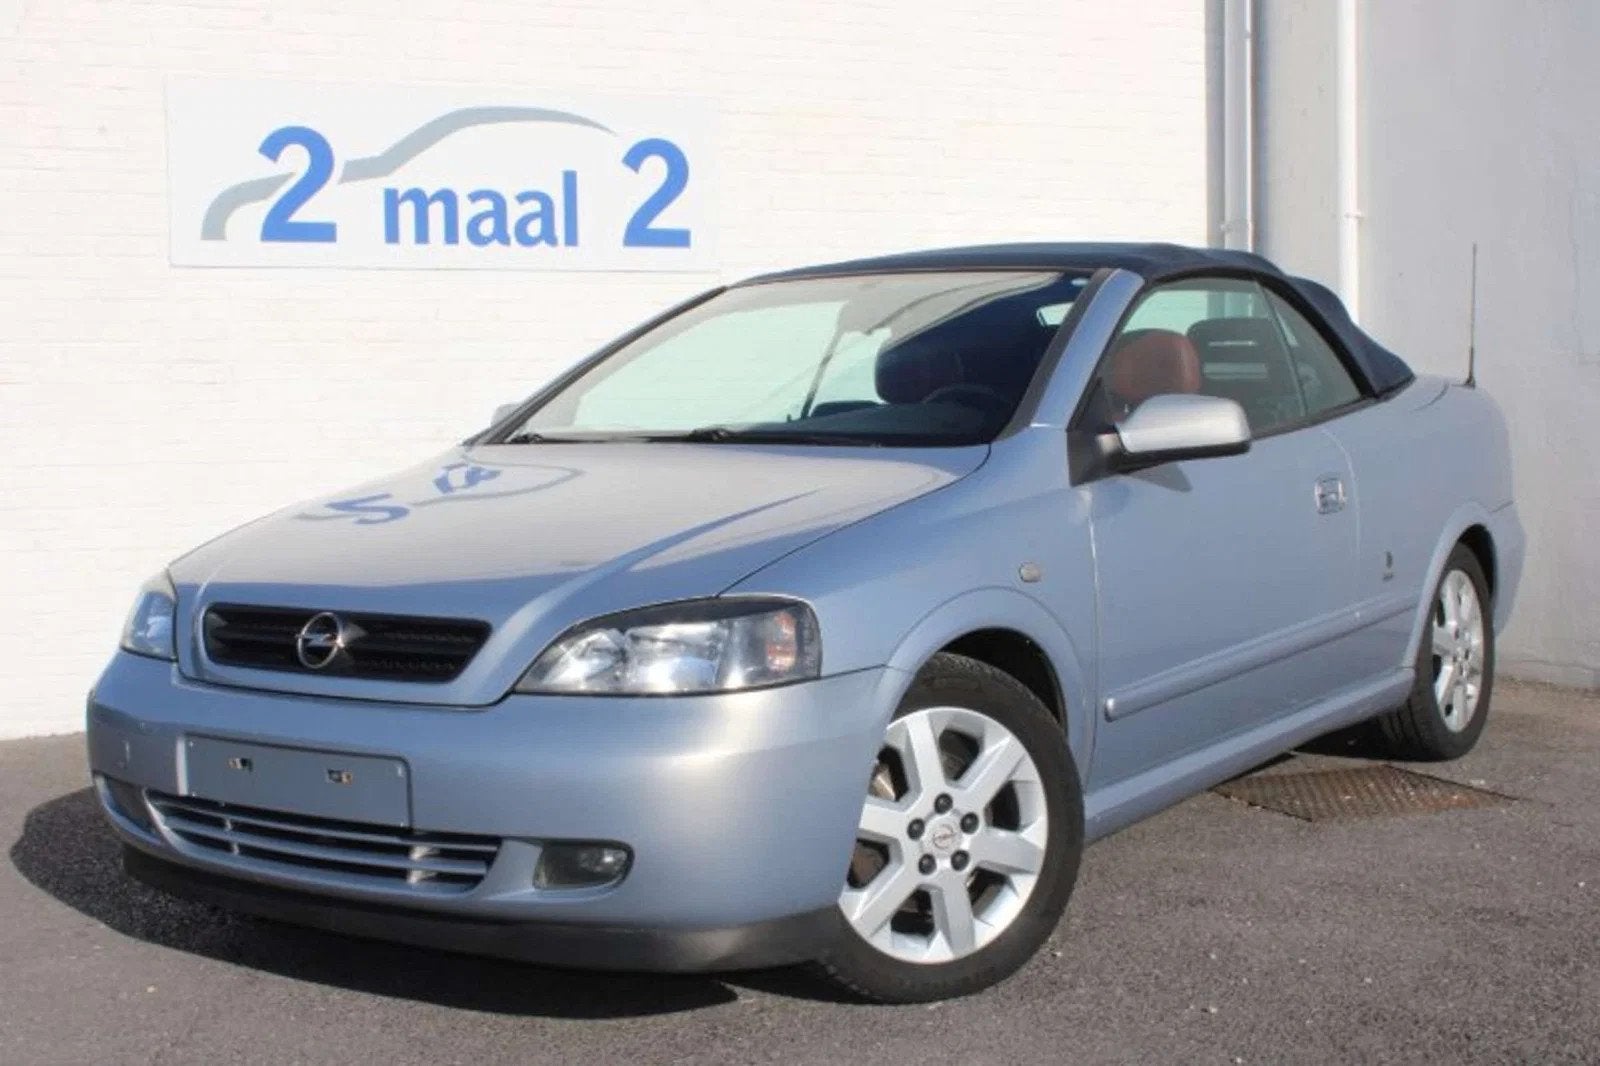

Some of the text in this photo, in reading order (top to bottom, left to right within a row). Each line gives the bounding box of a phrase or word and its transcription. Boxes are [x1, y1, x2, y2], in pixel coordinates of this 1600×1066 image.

[258, 125, 692, 248] 2 maal 2
